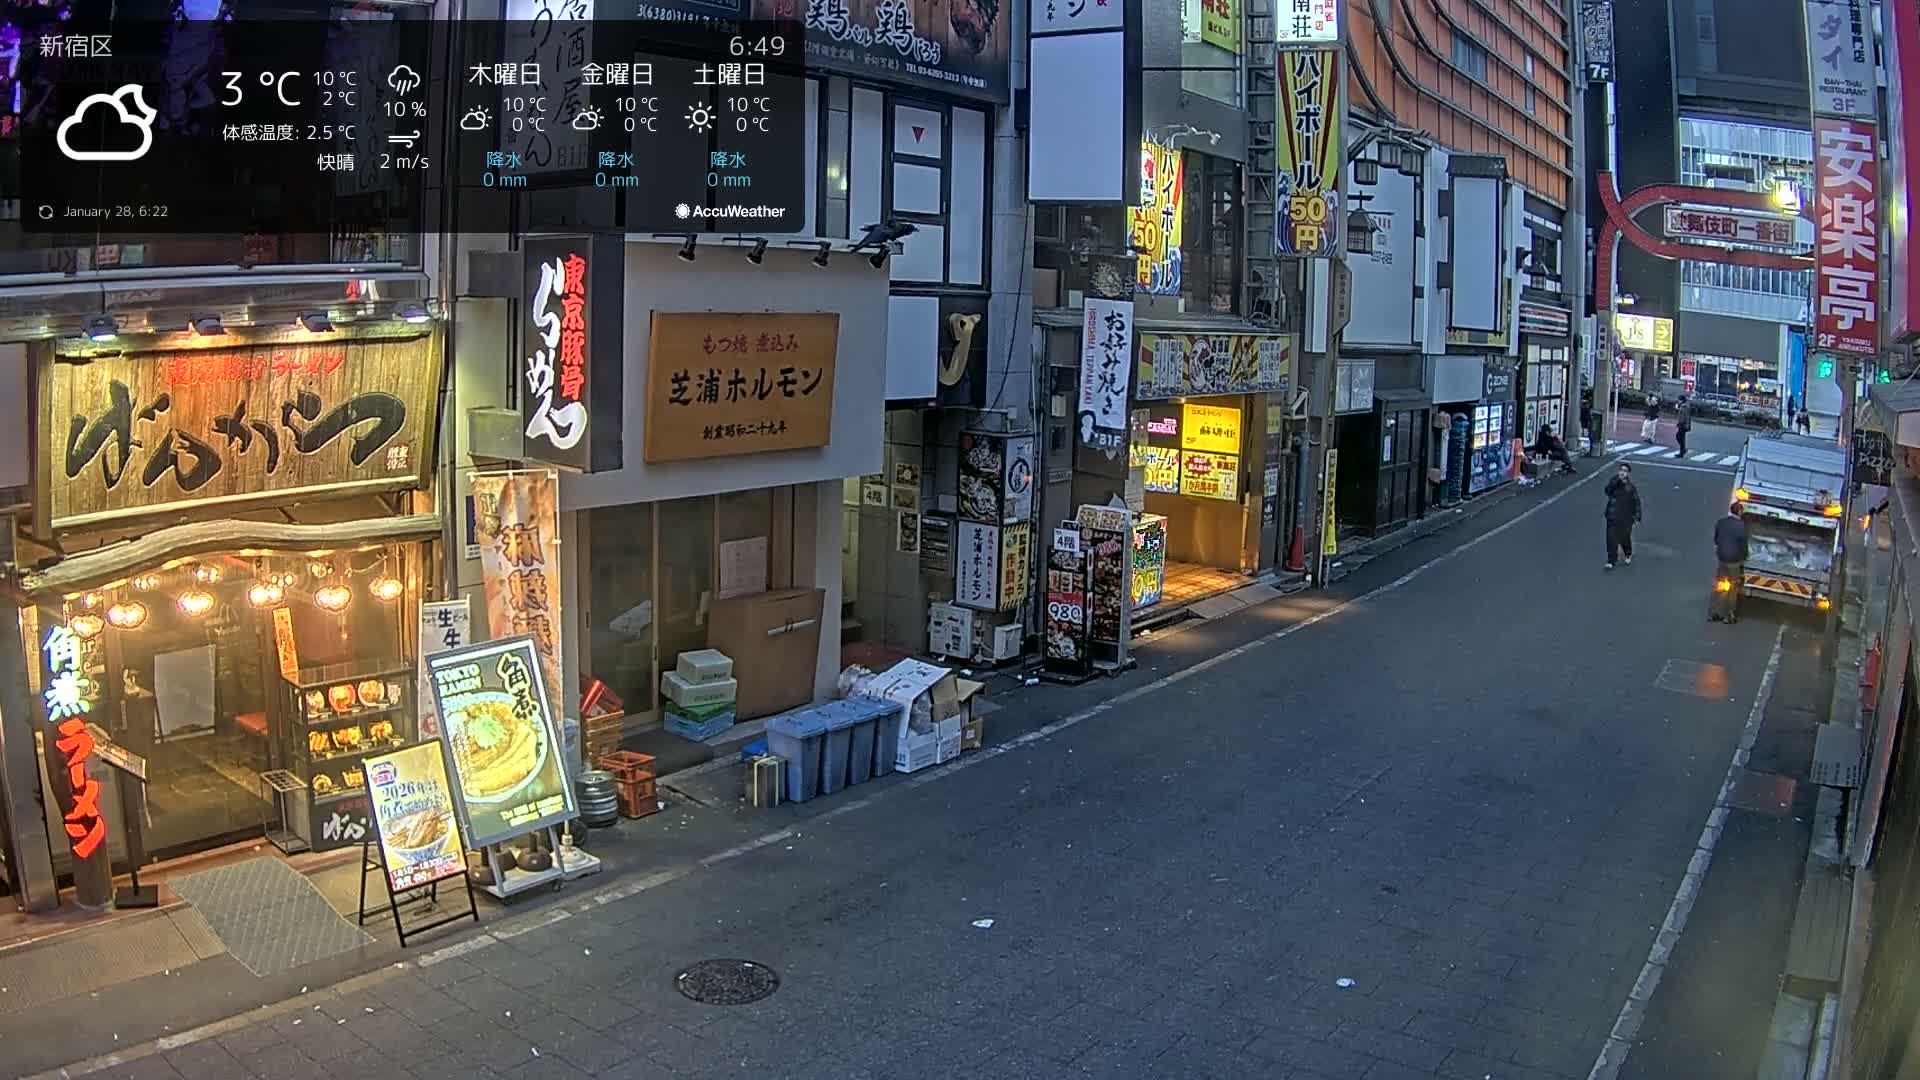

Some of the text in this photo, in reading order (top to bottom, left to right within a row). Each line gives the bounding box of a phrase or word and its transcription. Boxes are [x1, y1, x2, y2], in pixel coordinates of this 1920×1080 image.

[1589, 64, 1609, 79] 7F
[1832, 97, 1856, 112] 3F
[1295, 53, 1321, 191] ハイボール
[1160, 152, 1176, 289] ハイボール
[1819, 127, 1875, 330] 安楽亭
[561, 253, 586, 400] 東京豚骨
[1818, 333, 1836, 347] 2F
[702, 335, 749, 354] もつ焼
[1098, 310, 1127, 416] お好み焼き
[669, 366, 823, 406] 芝浦ホルモン
[1099, 433, 1122, 447] B1F
[1056, 535, 1077, 550] 4階
[972, 527, 983, 601] 芝浦ホルモン
[1048, 602, 1083, 622] 980
[435, 664, 480, 683] TOKYO
[500, 657, 537, 721] 角煮
[322, 812, 373, 841] ばん
